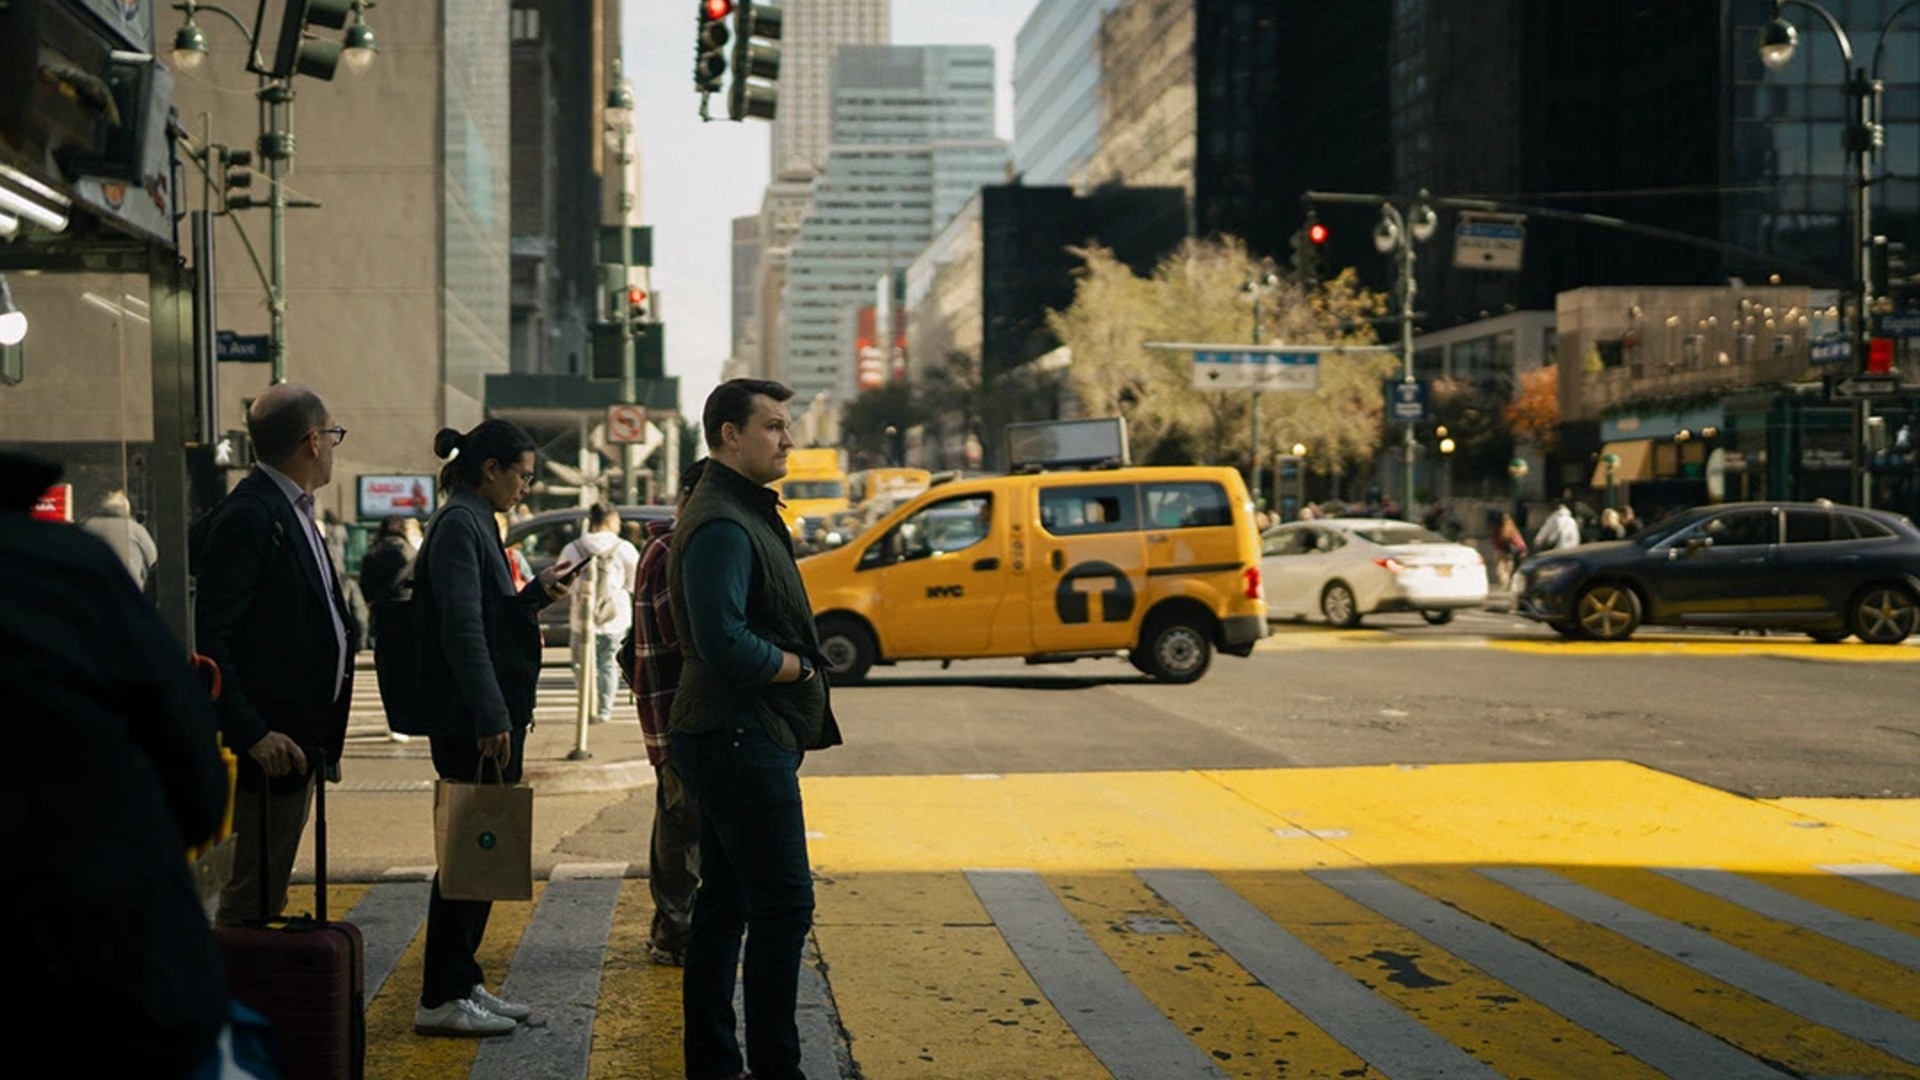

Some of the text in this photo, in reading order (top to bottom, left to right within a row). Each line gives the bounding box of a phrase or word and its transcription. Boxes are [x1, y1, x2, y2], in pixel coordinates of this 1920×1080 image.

[229, 341, 257, 355] Ave
[926, 585, 964, 598] NYC
[1072, 576, 1117, 623] T
